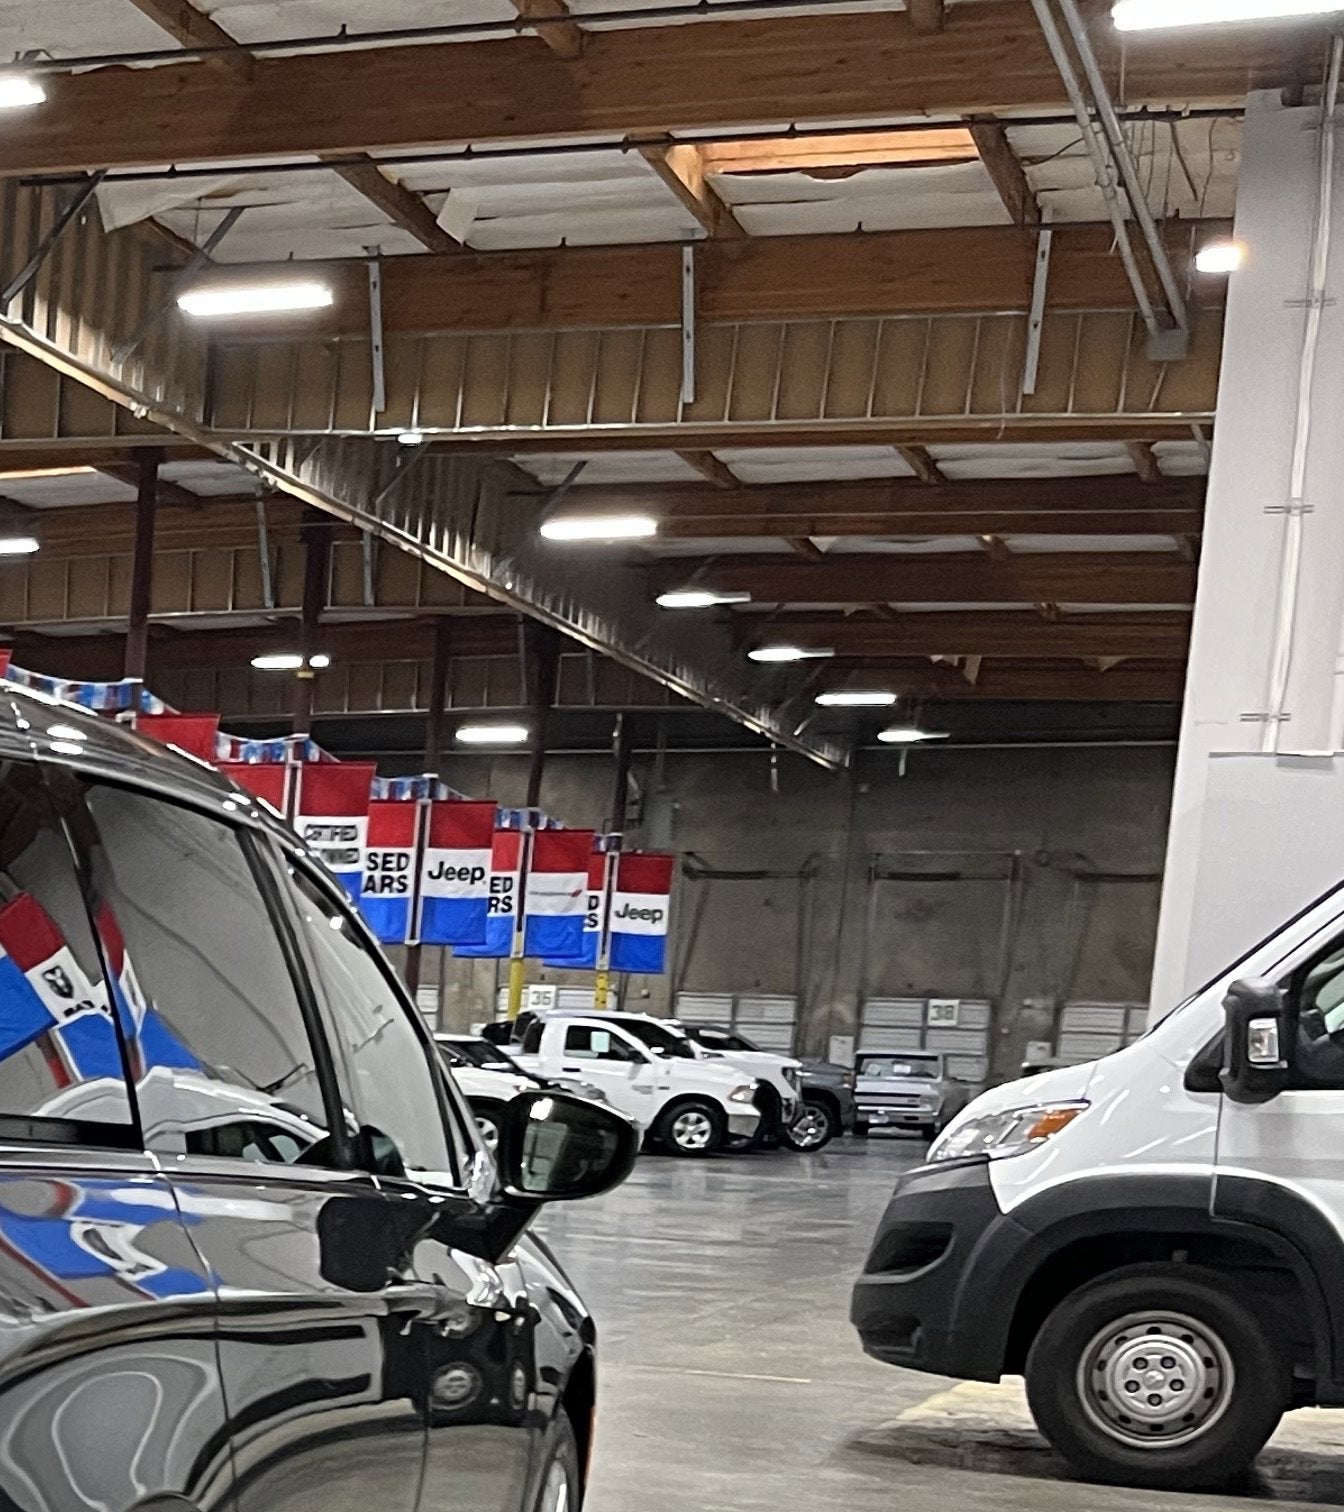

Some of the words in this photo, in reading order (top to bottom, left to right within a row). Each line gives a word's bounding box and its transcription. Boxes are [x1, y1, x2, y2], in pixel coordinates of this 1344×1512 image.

[366, 852, 410, 873] SED
[427, 861, 485, 885] Jeep
[363, 874, 408, 894] ARS
[614, 903, 664, 924] Jeep
